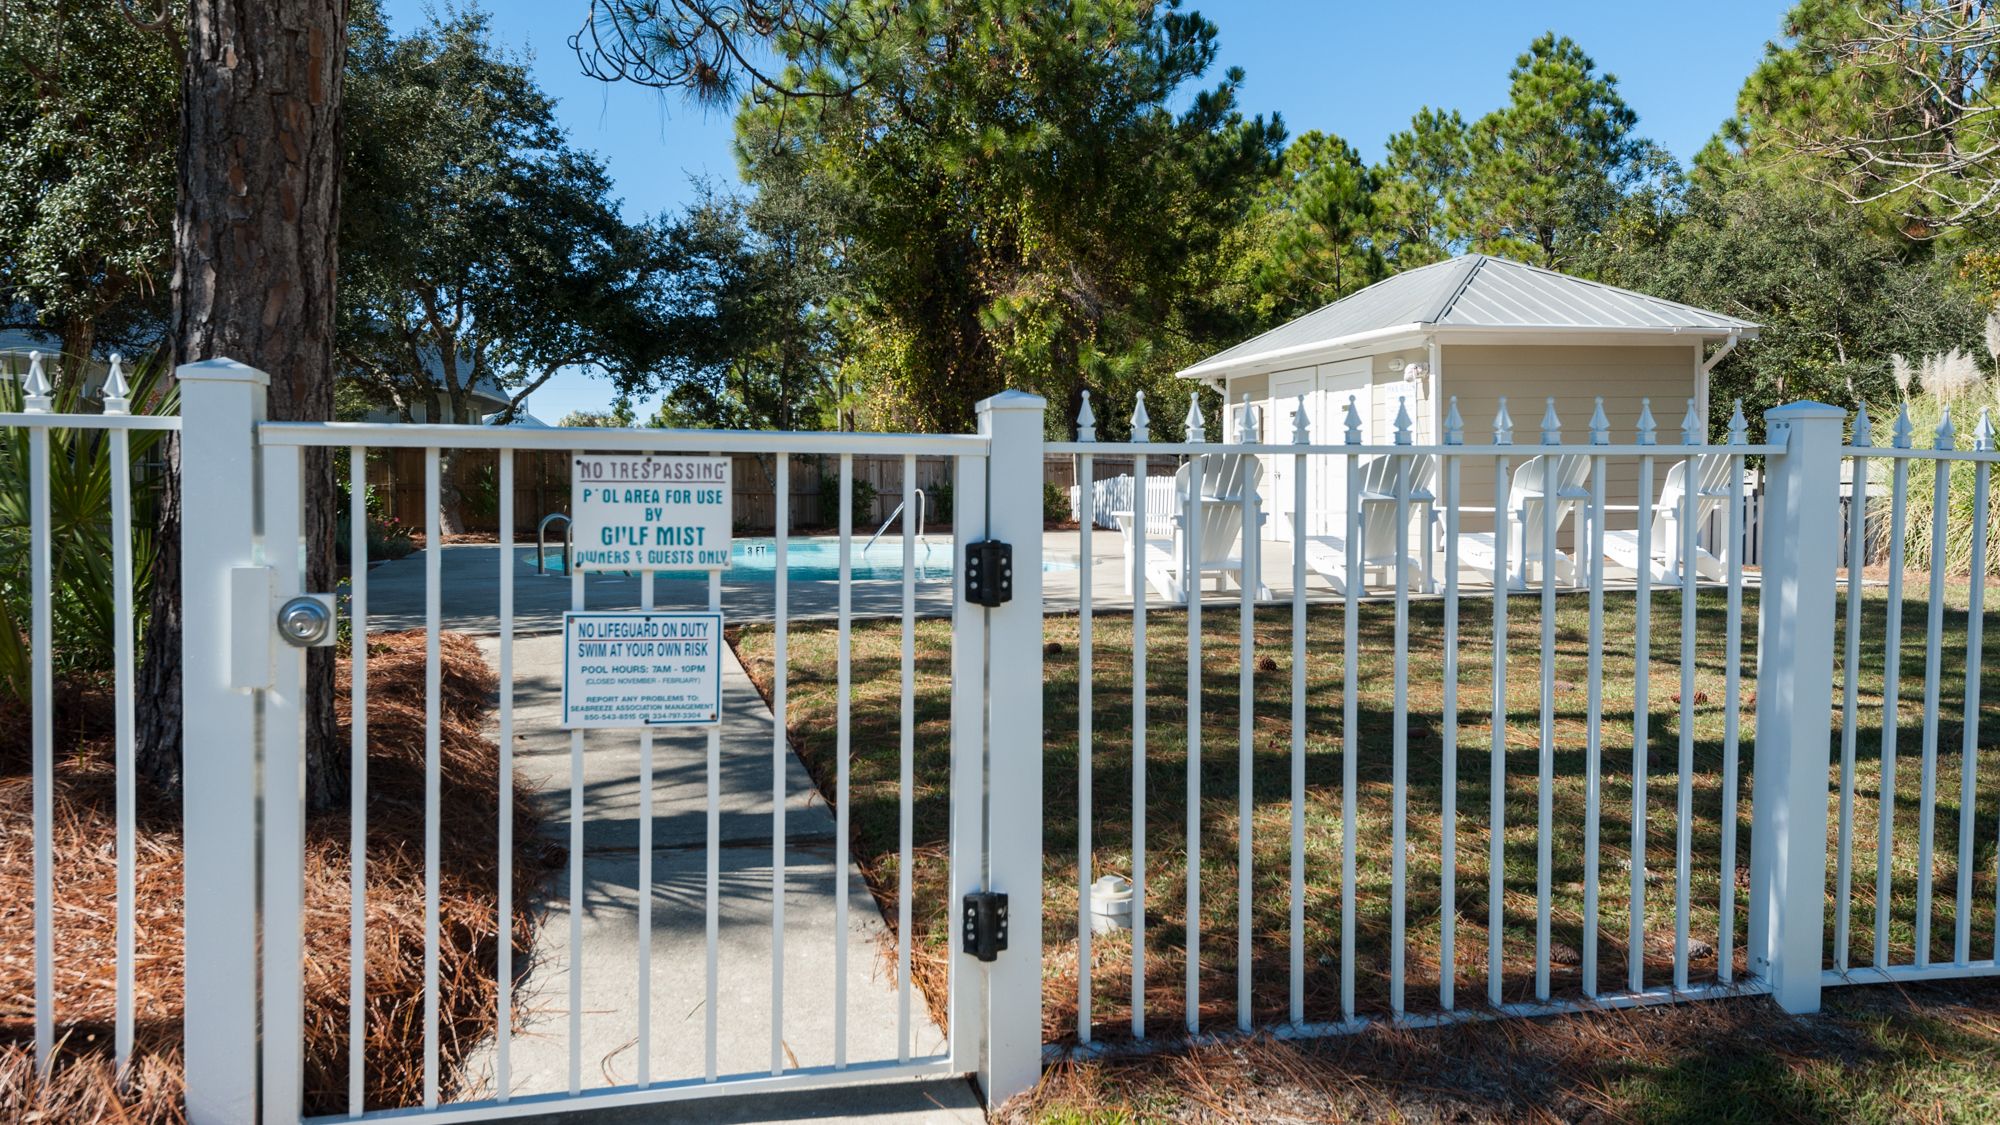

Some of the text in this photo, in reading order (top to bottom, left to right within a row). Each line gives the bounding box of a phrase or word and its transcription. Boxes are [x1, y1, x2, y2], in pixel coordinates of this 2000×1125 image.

[582, 462, 724, 479] NO TRESPASSING
[584, 489, 722, 504] POL AREA FOR USE
[645, 508, 662, 521] BY
[656, 526, 705, 545] MIST
[577, 550, 630, 564] OWNERS
[649, 550, 693, 564] GUESTS
[700, 550, 727, 564] ONLY
[748, 546, 765, 556] 3 FT
[579, 622, 708, 637] NO LIFEGUARD ON DUTY
[578, 643, 708, 657] SWIM AT YOUR OWN RISK
[581, 666, 608, 674] POOL
